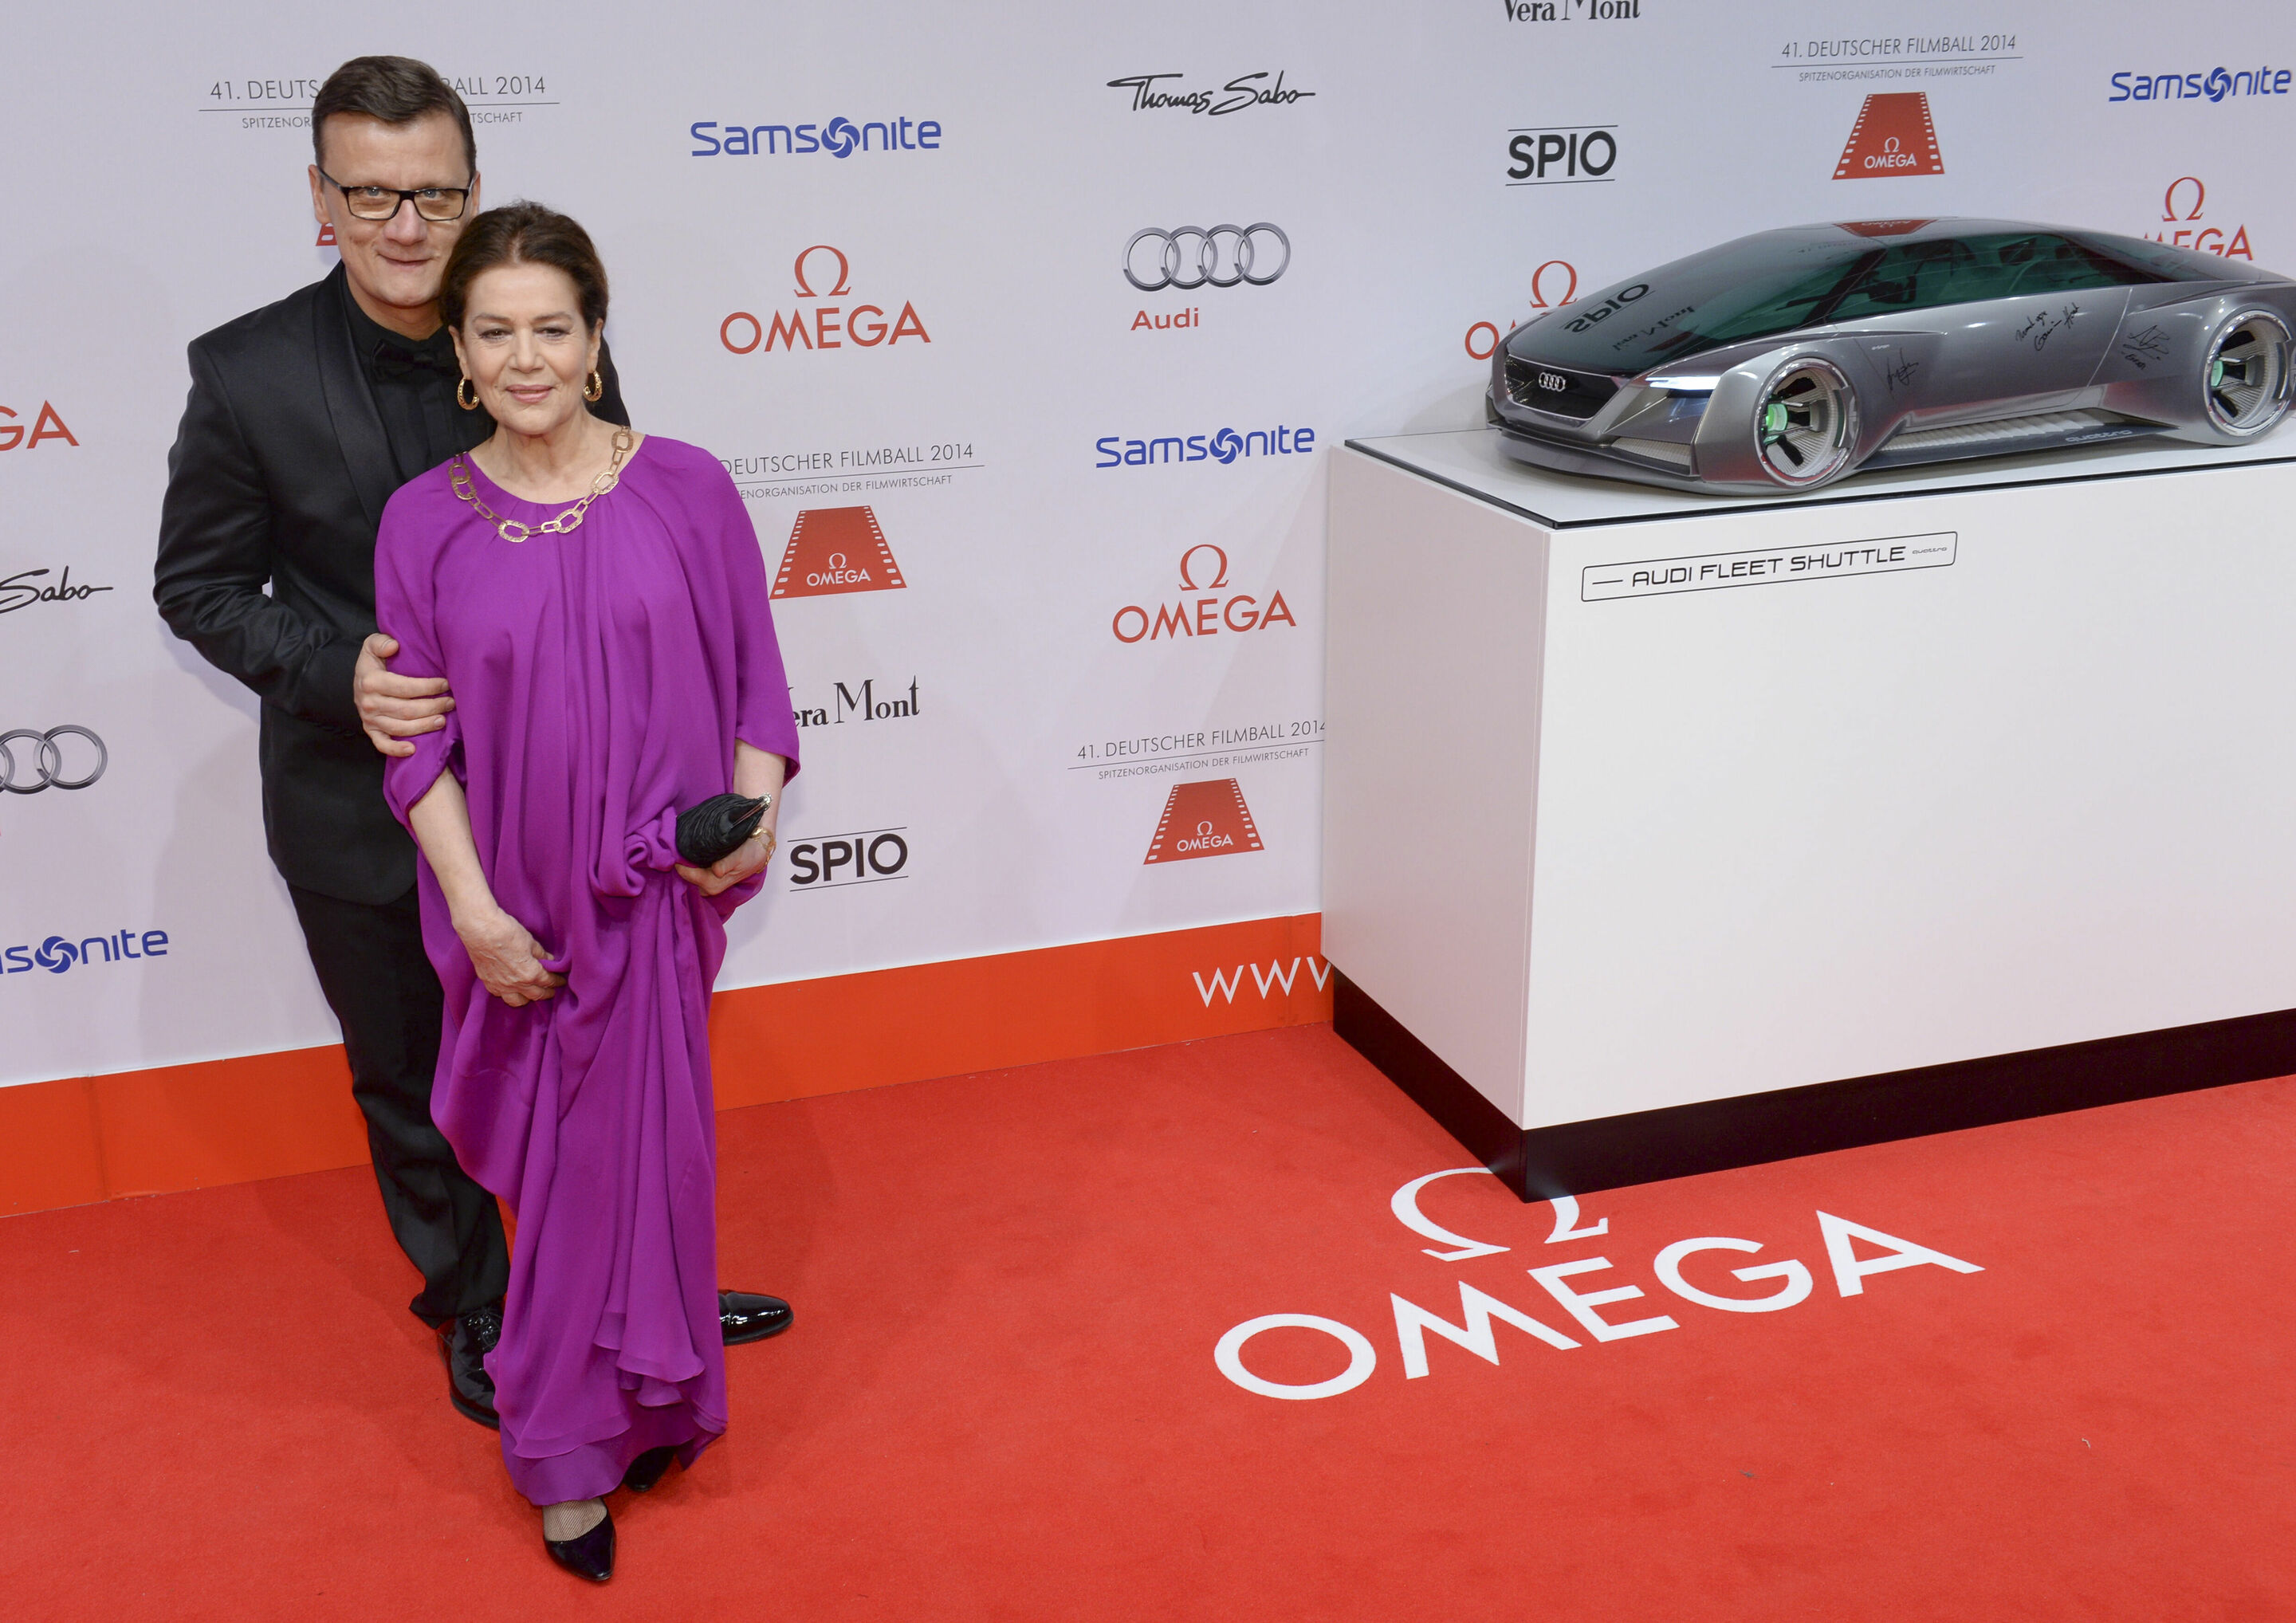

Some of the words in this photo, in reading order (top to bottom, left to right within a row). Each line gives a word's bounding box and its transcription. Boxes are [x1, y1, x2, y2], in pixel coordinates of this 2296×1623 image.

[1782, 42, 1802, 57] 41.
[1808, 39, 1901, 57] DEUTSCHER
[1908, 37, 1974, 53] FILMBALL
[1981, 35, 2015, 50] 2014
[210, 81, 240, 99] 41.
[246, 77, 319, 100] DEUTS
[497, 77, 545, 94] 2014
[1799, 69, 1901, 81] SPITZENORGANISATION
[1905, 69, 1921, 77] DER
[1924, 65, 1995, 76] FILMWIRTSCHAFT
[2109, 67, 2291, 102] Samsonite
[1103, 70, 1214, 115] Thomas
[1208, 69, 1317, 116] Sabo
[691, 116, 941, 159] Samsonite
[1506, 131, 1618, 179] SPIO
[1862, 152, 1918, 171] OMEGA
[721, 300, 930, 354] OMEGA
[1131, 308, 1198, 330] Audi
[841, 447, 923, 467] FILMBALL
[931, 444, 973, 461] 2014
[1096, 426, 1315, 468] Samsonite
[843, 482, 861, 491] DER
[866, 475, 952, 489] FILMWIRTSCHAFT
[806, 568, 871, 587] OMEGA
[1632, 568, 1692, 587] AUDI
[1700, 559, 1783, 580] FLEET
[1790, 546, 1906, 571] SHUTTLE
[1113, 590, 1296, 643] OMEGA
[834, 676, 919, 724] Mont
[1078, 745, 1099, 759] 41.
[1107, 733, 1205, 756] DEUTSCHER
[1213, 724, 1284, 745] FILMBALL
[1099, 760, 1209, 780] SPITZENORGANISATION
[1213, 757, 1229, 766] DER
[1233, 748, 1308, 764] FILMWIRTSCHAFT
[789, 833, 908, 885] SPIO
[1177, 834, 1234, 852] OMEGA
[0, 929, 168, 974] sonite
[1214, 1210, 1985, 1400] OMEGA
